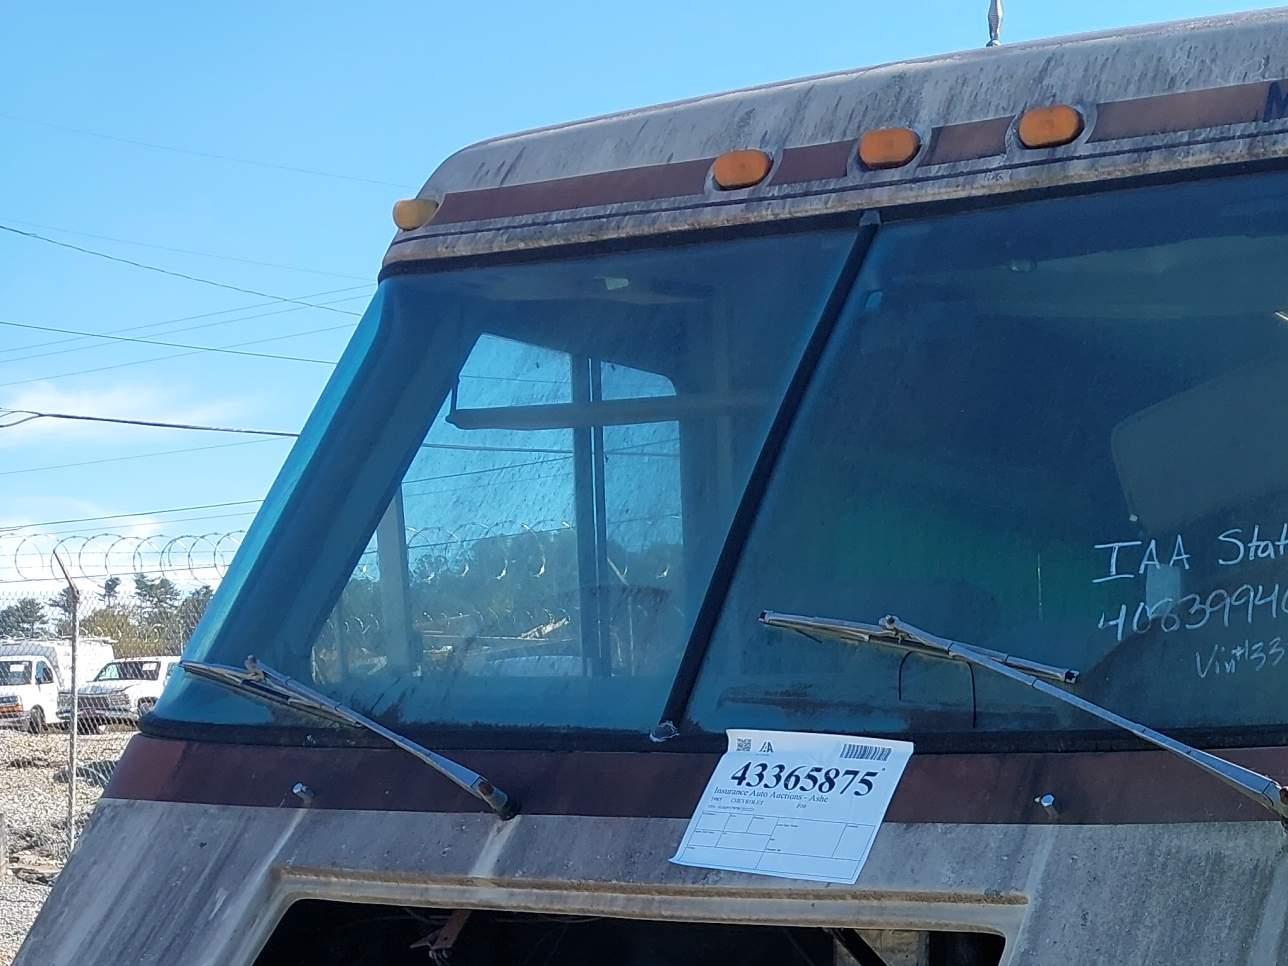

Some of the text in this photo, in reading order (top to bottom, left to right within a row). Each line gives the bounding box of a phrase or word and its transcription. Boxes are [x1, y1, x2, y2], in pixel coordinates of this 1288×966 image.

[1092, 534, 1191, 583] IAA
[714, 786, 749, 797] Insurance
[749, 789, 768, 798] Auto
[770, 791, 803, 801] Auctions
[731, 761, 878, 797] 43365875
